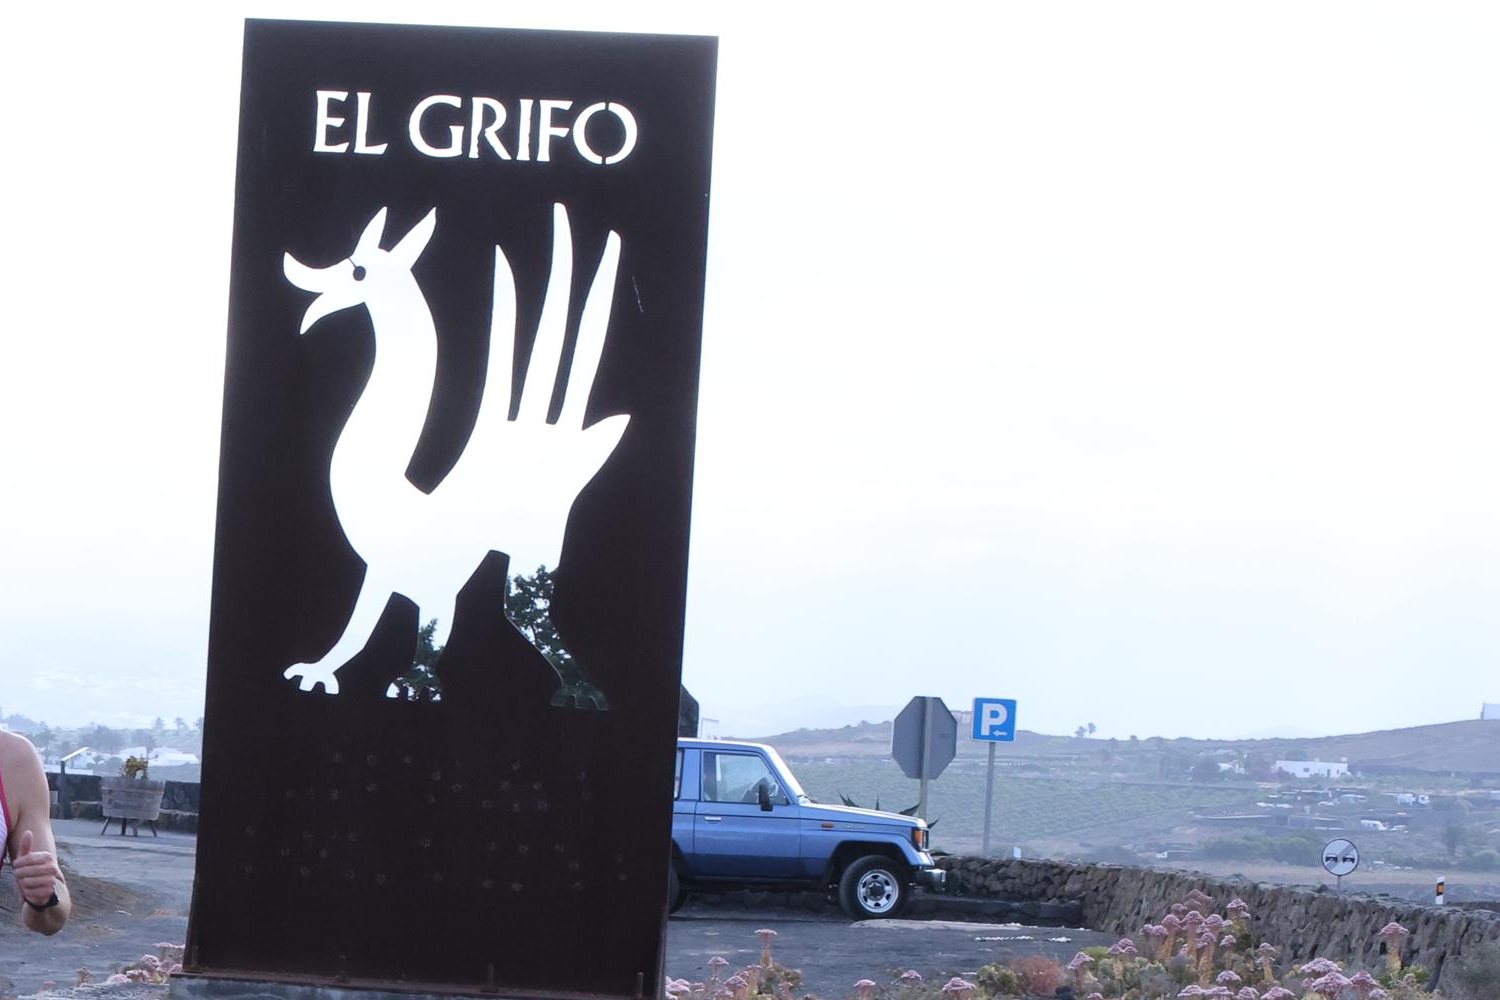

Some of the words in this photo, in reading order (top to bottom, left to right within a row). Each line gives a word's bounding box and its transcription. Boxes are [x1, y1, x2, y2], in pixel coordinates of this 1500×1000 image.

[312, 89, 388, 155] EL
[408, 94, 638, 165] GRIFO
[981, 702, 1008, 736] P
